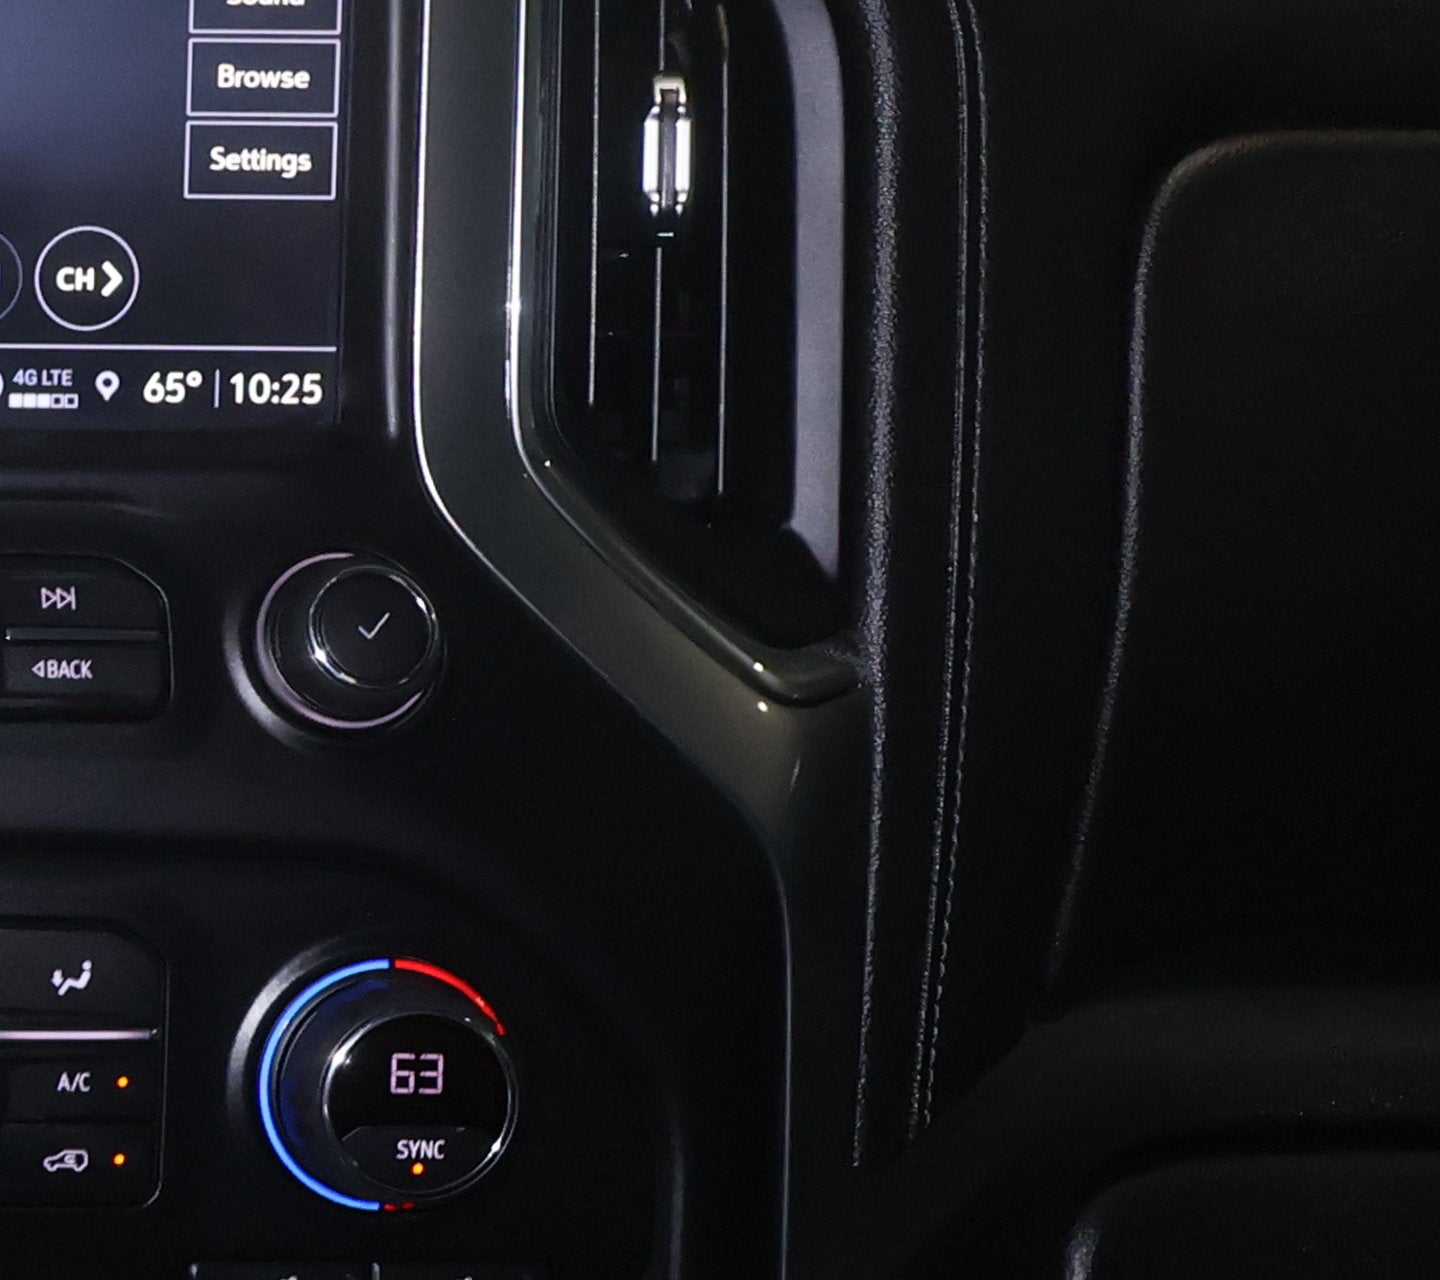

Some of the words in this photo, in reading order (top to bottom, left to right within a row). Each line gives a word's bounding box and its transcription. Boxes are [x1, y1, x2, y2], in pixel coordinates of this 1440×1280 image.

[217, 63, 311, 89] Browse
[209, 145, 312, 179] Settings
[55, 266, 96, 293] CH
[11, 369, 38, 387] 4G
[40, 369, 74, 387] LTE
[229, 371, 323, 406] 10:25
[46, 658, 94, 680] BACK
[57, 1071, 92, 1094] A/C
[390, 1052, 445, 1096] 63
[395, 1138, 446, 1160] SYNC
